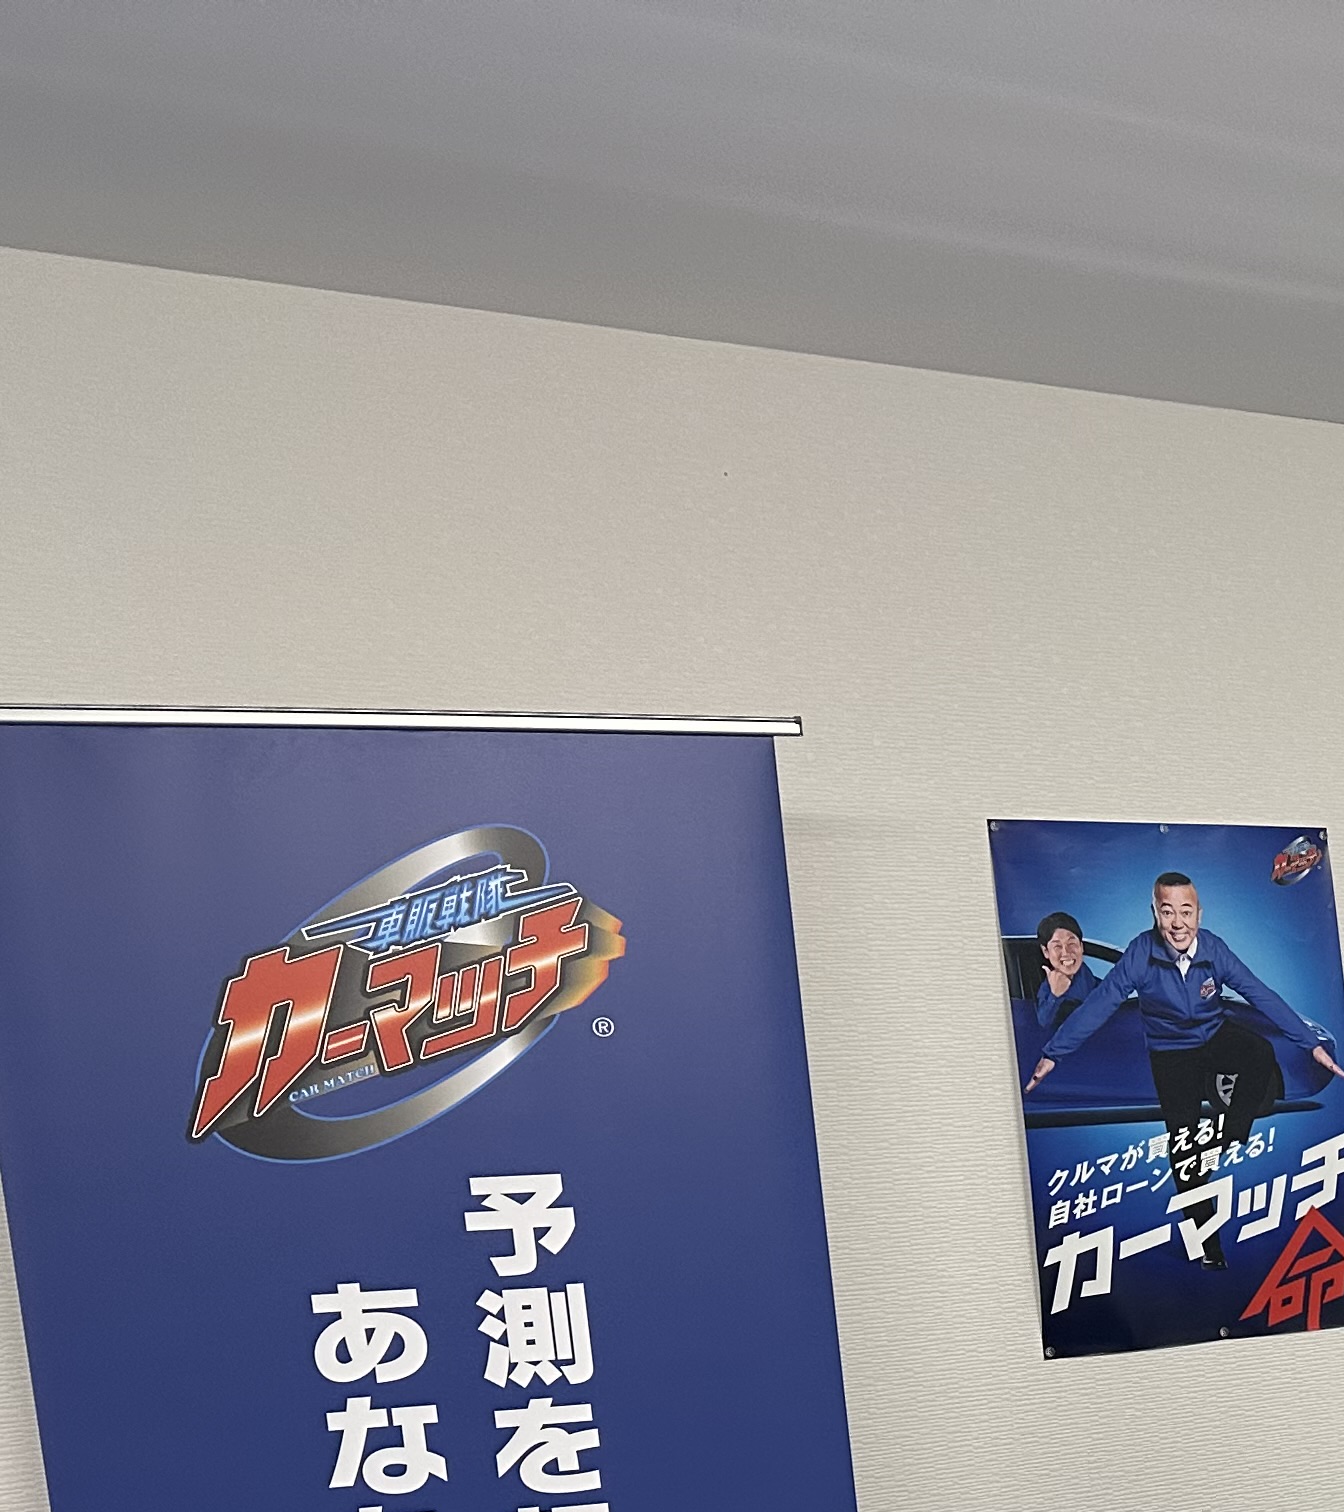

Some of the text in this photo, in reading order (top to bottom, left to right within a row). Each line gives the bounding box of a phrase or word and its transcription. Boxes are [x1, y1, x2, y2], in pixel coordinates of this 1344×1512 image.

[374, 876, 508, 950] 車販戦隊
[191, 896, 591, 1139] カーマッチ
[289, 1064, 377, 1103] CAR MATCH
